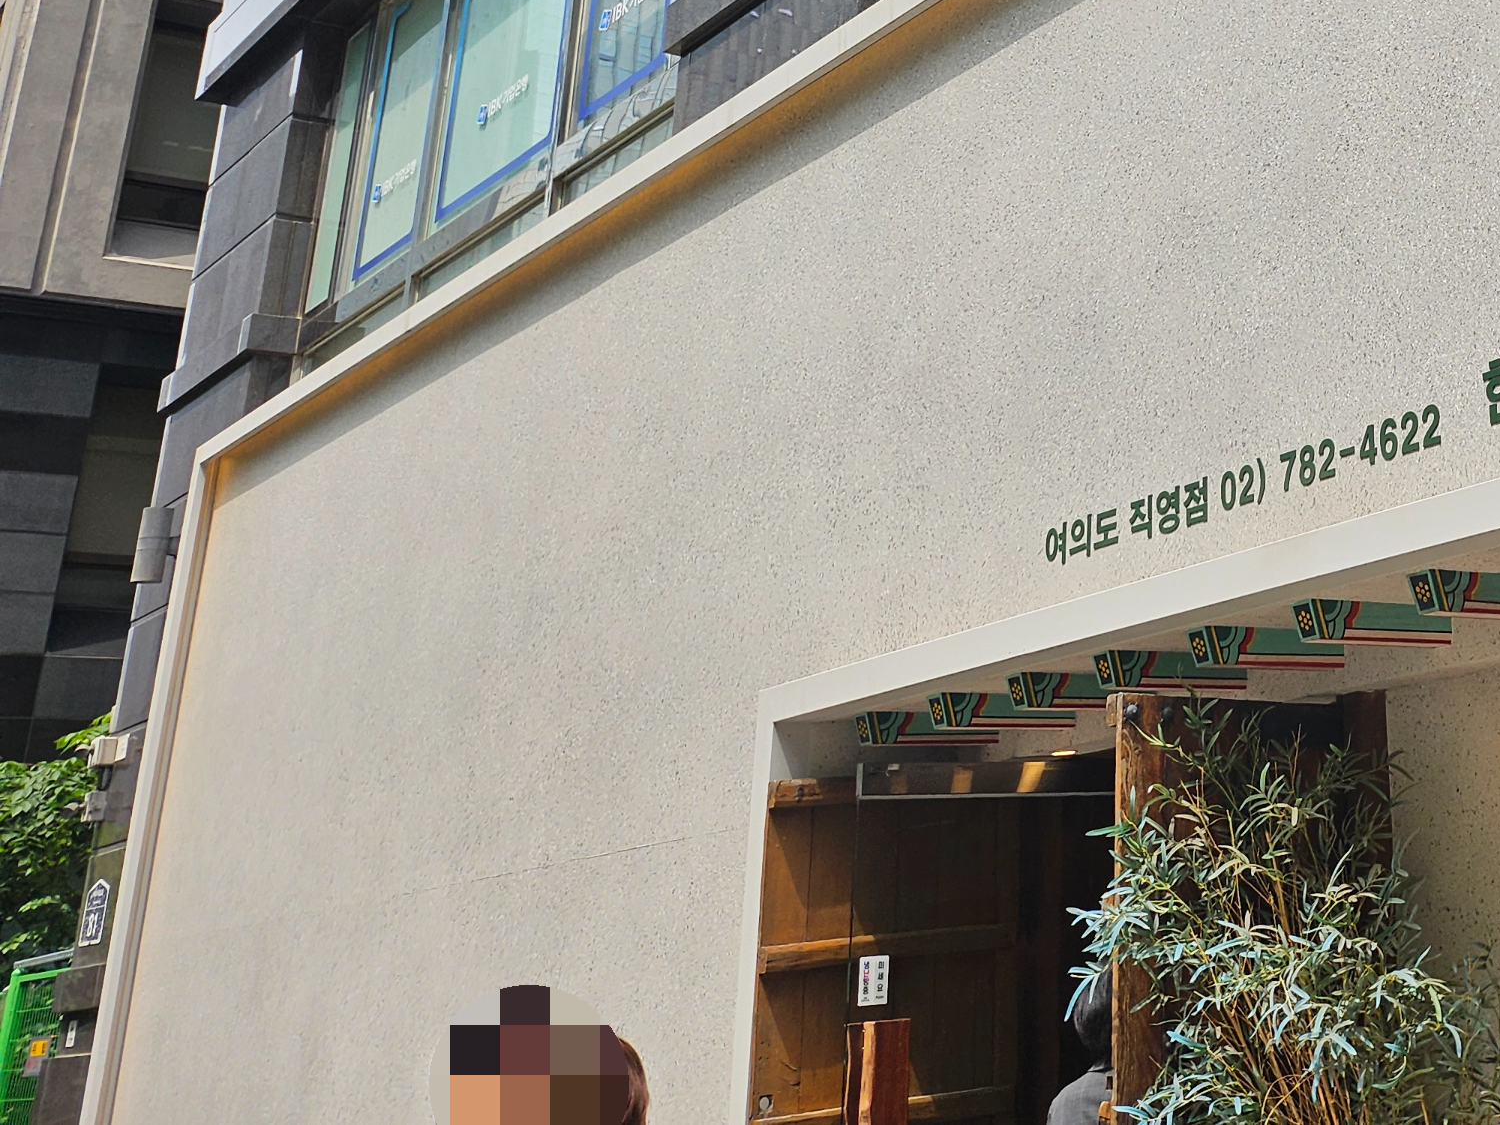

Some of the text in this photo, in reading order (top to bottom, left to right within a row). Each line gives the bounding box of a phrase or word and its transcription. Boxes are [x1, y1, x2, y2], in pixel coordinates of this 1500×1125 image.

[1044, 403, 1442, 567] 여의도 직영점 02) 782-4622
